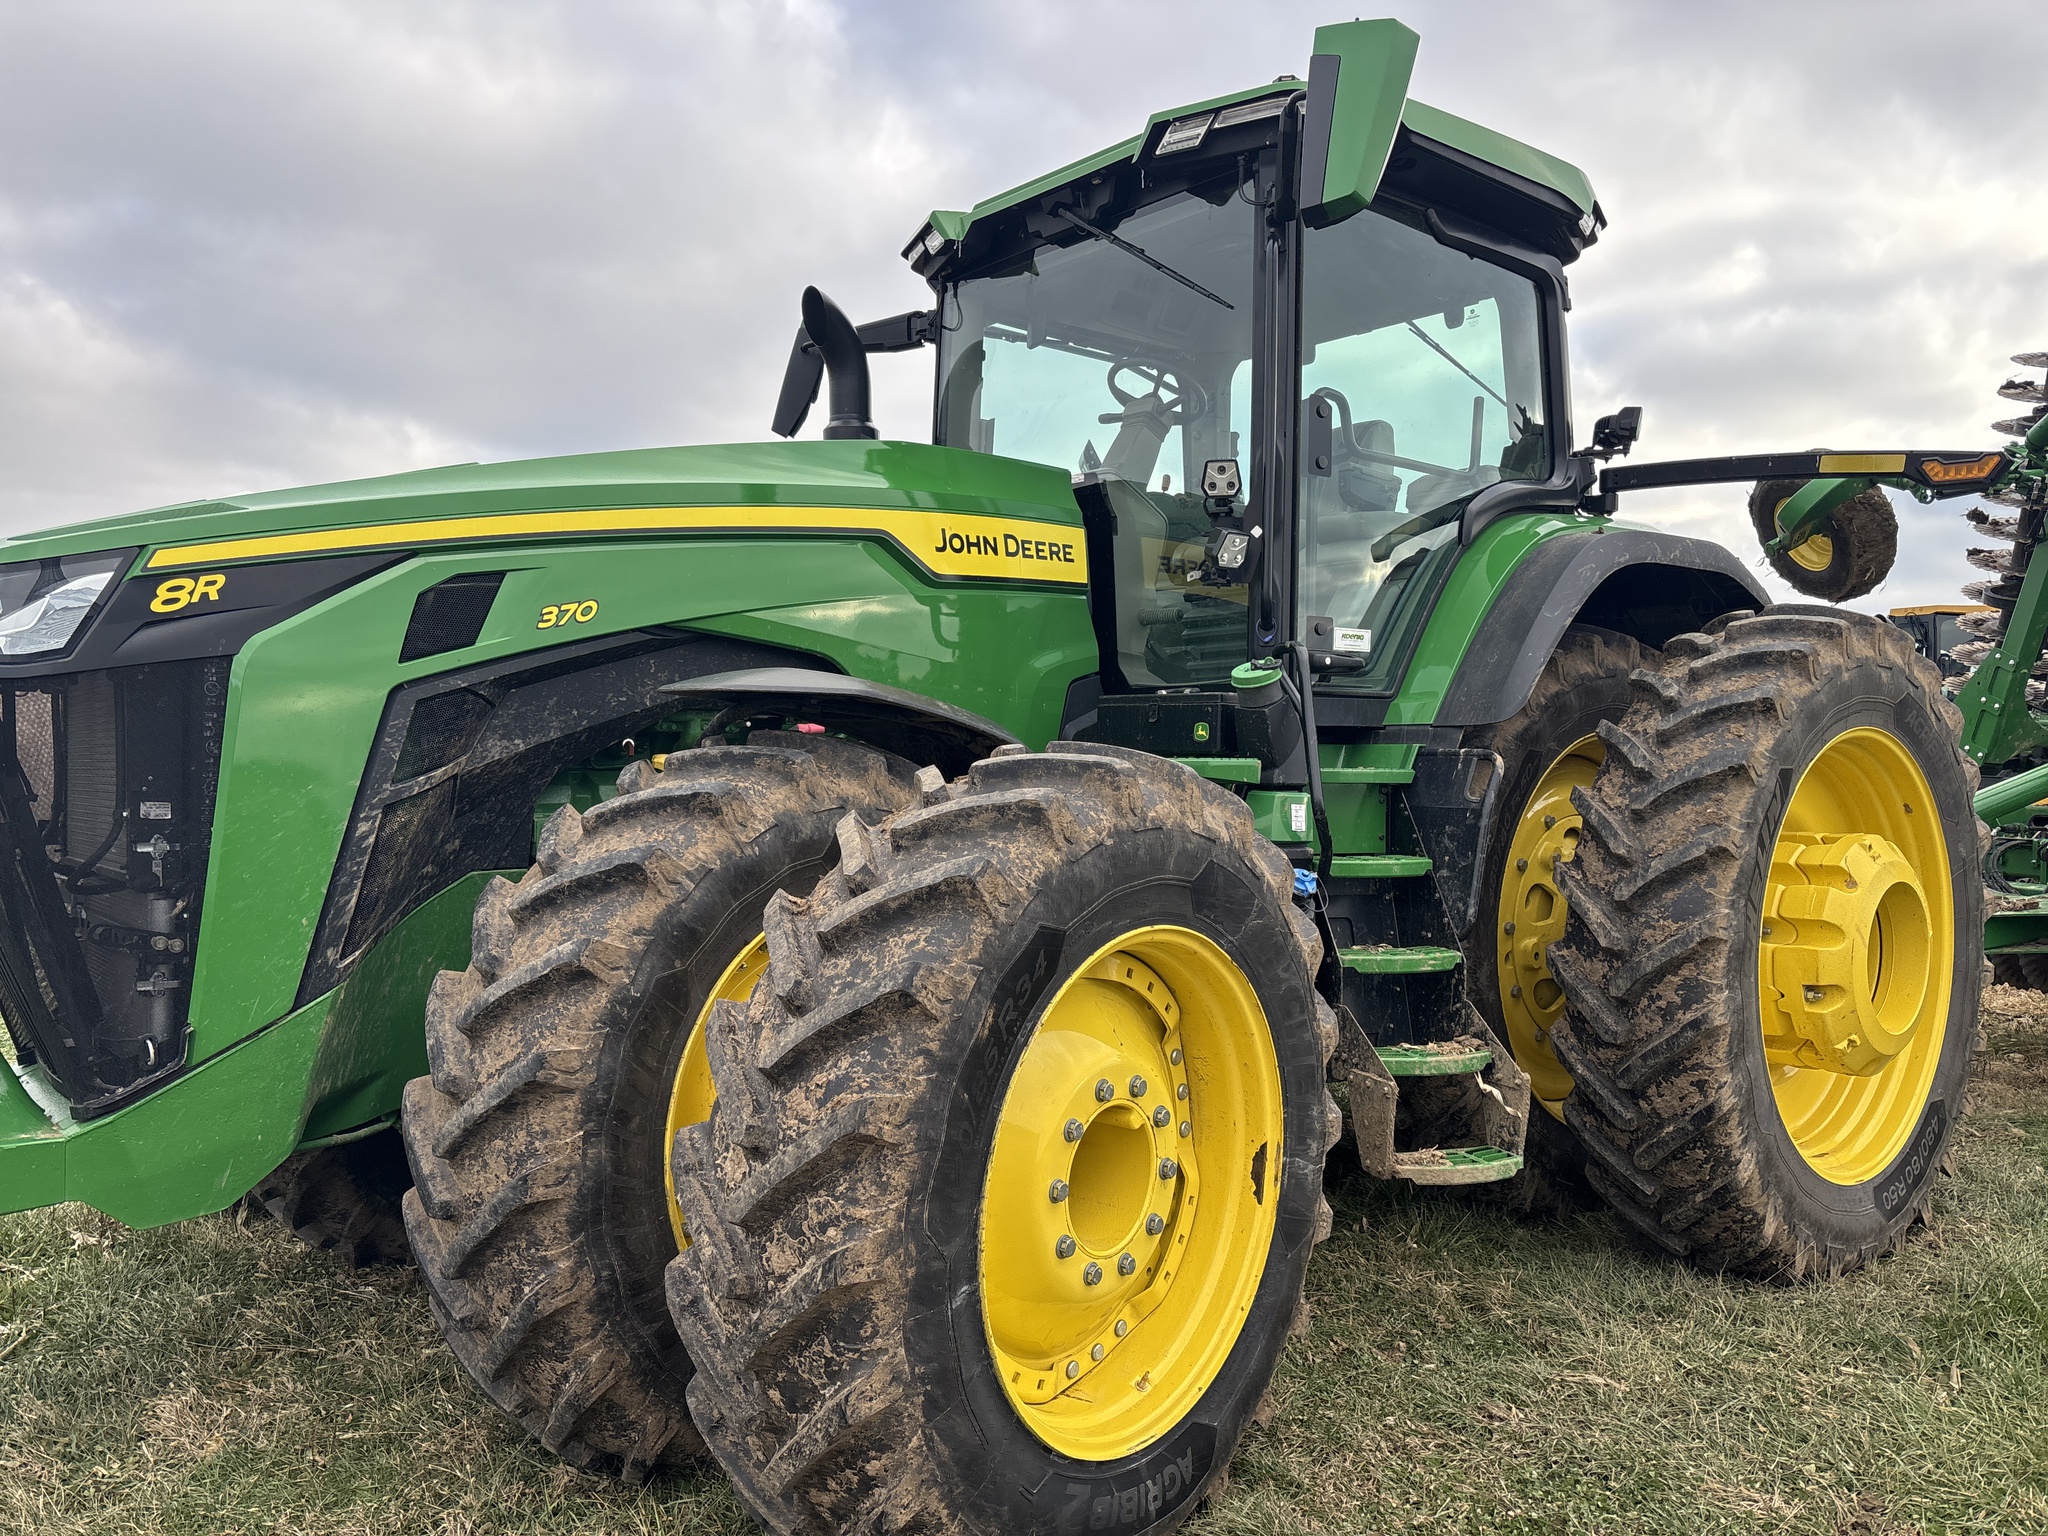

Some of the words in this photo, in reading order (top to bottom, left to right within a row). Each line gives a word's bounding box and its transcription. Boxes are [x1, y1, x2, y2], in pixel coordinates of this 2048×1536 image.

[934, 528, 998, 556] JOHN
[1003, 533, 1075, 563] DEERE
[149, 573, 227, 614] 8R
[537, 599, 598, 630] 370
[1088, 1446, 1194, 1532] AGRIBIB
